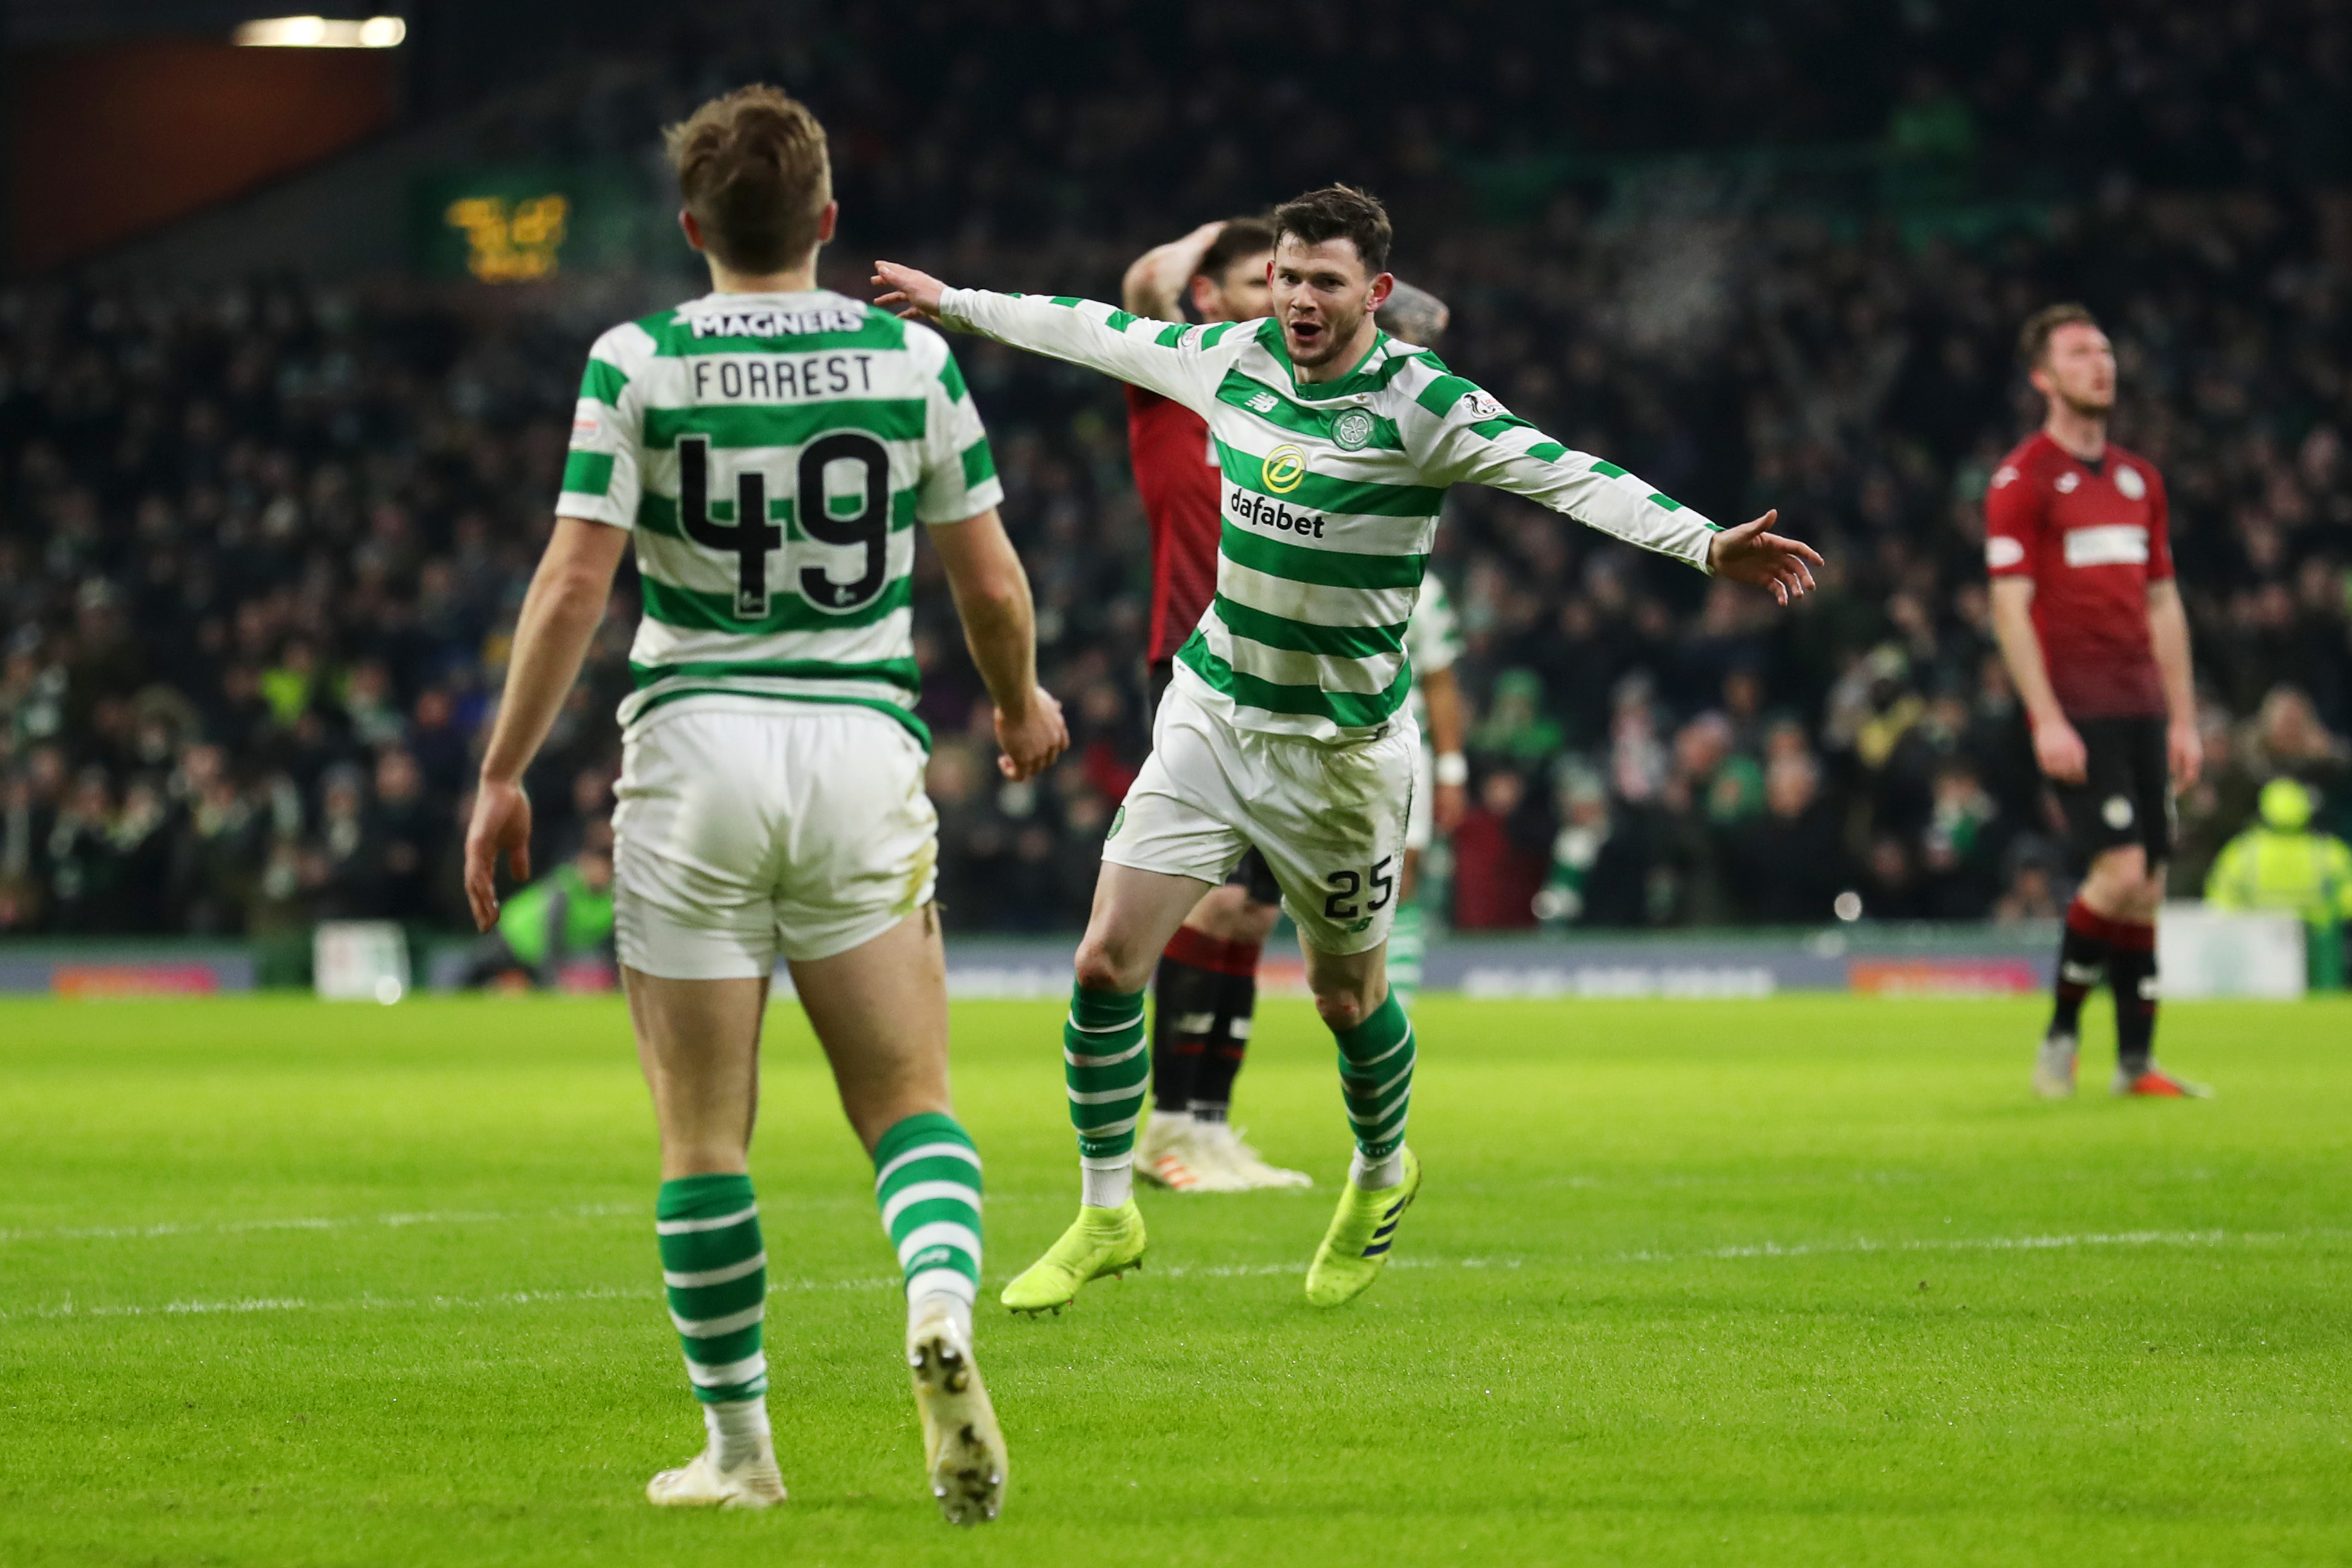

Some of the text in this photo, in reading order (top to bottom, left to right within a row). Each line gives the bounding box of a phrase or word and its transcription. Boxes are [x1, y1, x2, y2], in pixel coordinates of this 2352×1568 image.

[691, 310, 864, 339] MAGNERS
[695, 355, 871, 399] FORREST
[676, 429, 891, 617] 49
[1231, 488, 1325, 538] dafabet
[1325, 854, 1392, 918] 25
